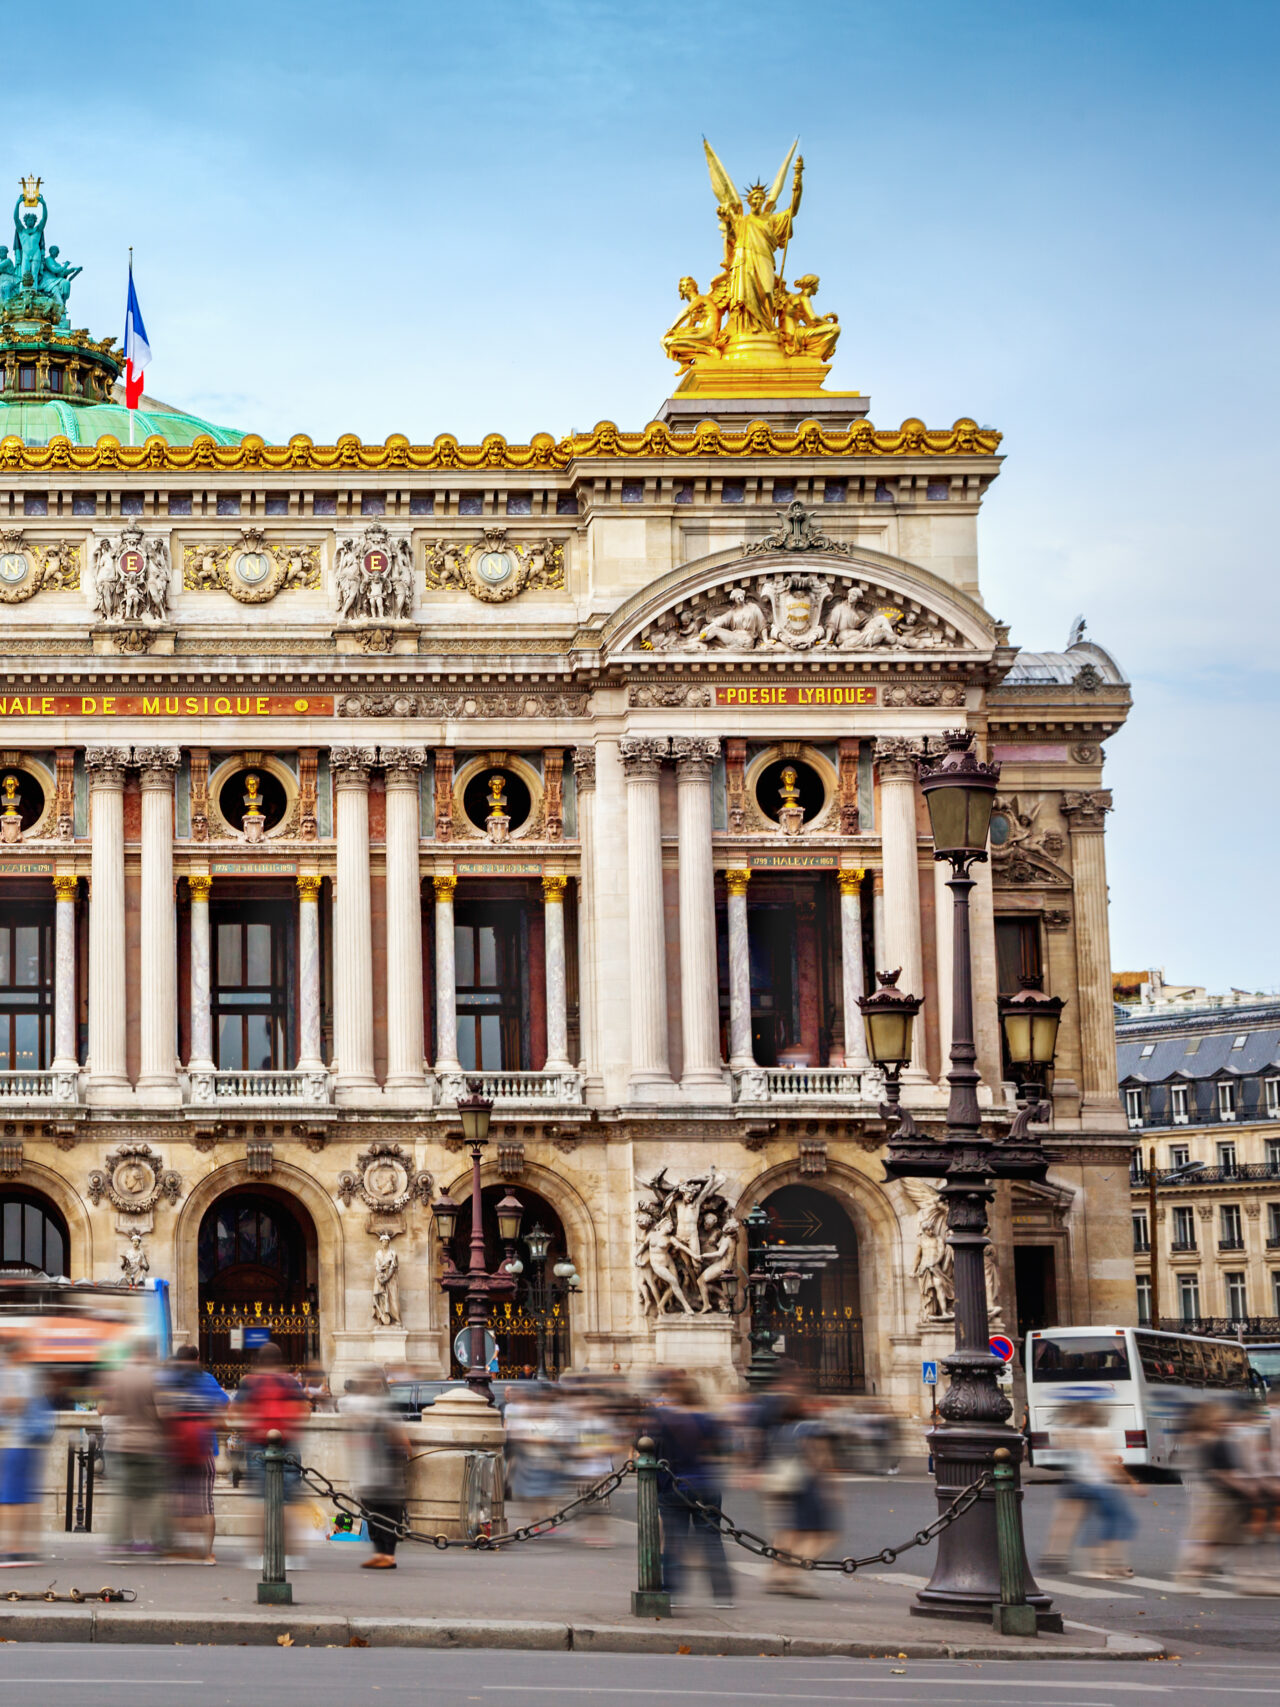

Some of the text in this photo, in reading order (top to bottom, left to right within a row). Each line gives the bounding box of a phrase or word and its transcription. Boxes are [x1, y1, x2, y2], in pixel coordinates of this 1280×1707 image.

[3, 558, 20, 576] N
[126, 555, 138, 571] E
[244, 558, 261, 576] N
[370, 555, 382, 570] E
[487, 557, 503, 575] N
[726, 688, 867, 705] POESIE LYRIQUE
[81, 697, 117, 715] DE
[142, 697, 270, 715] MUSIQUE
[38, 864, 50, 872] 1791
[773, 856, 815, 866] HALEVY
